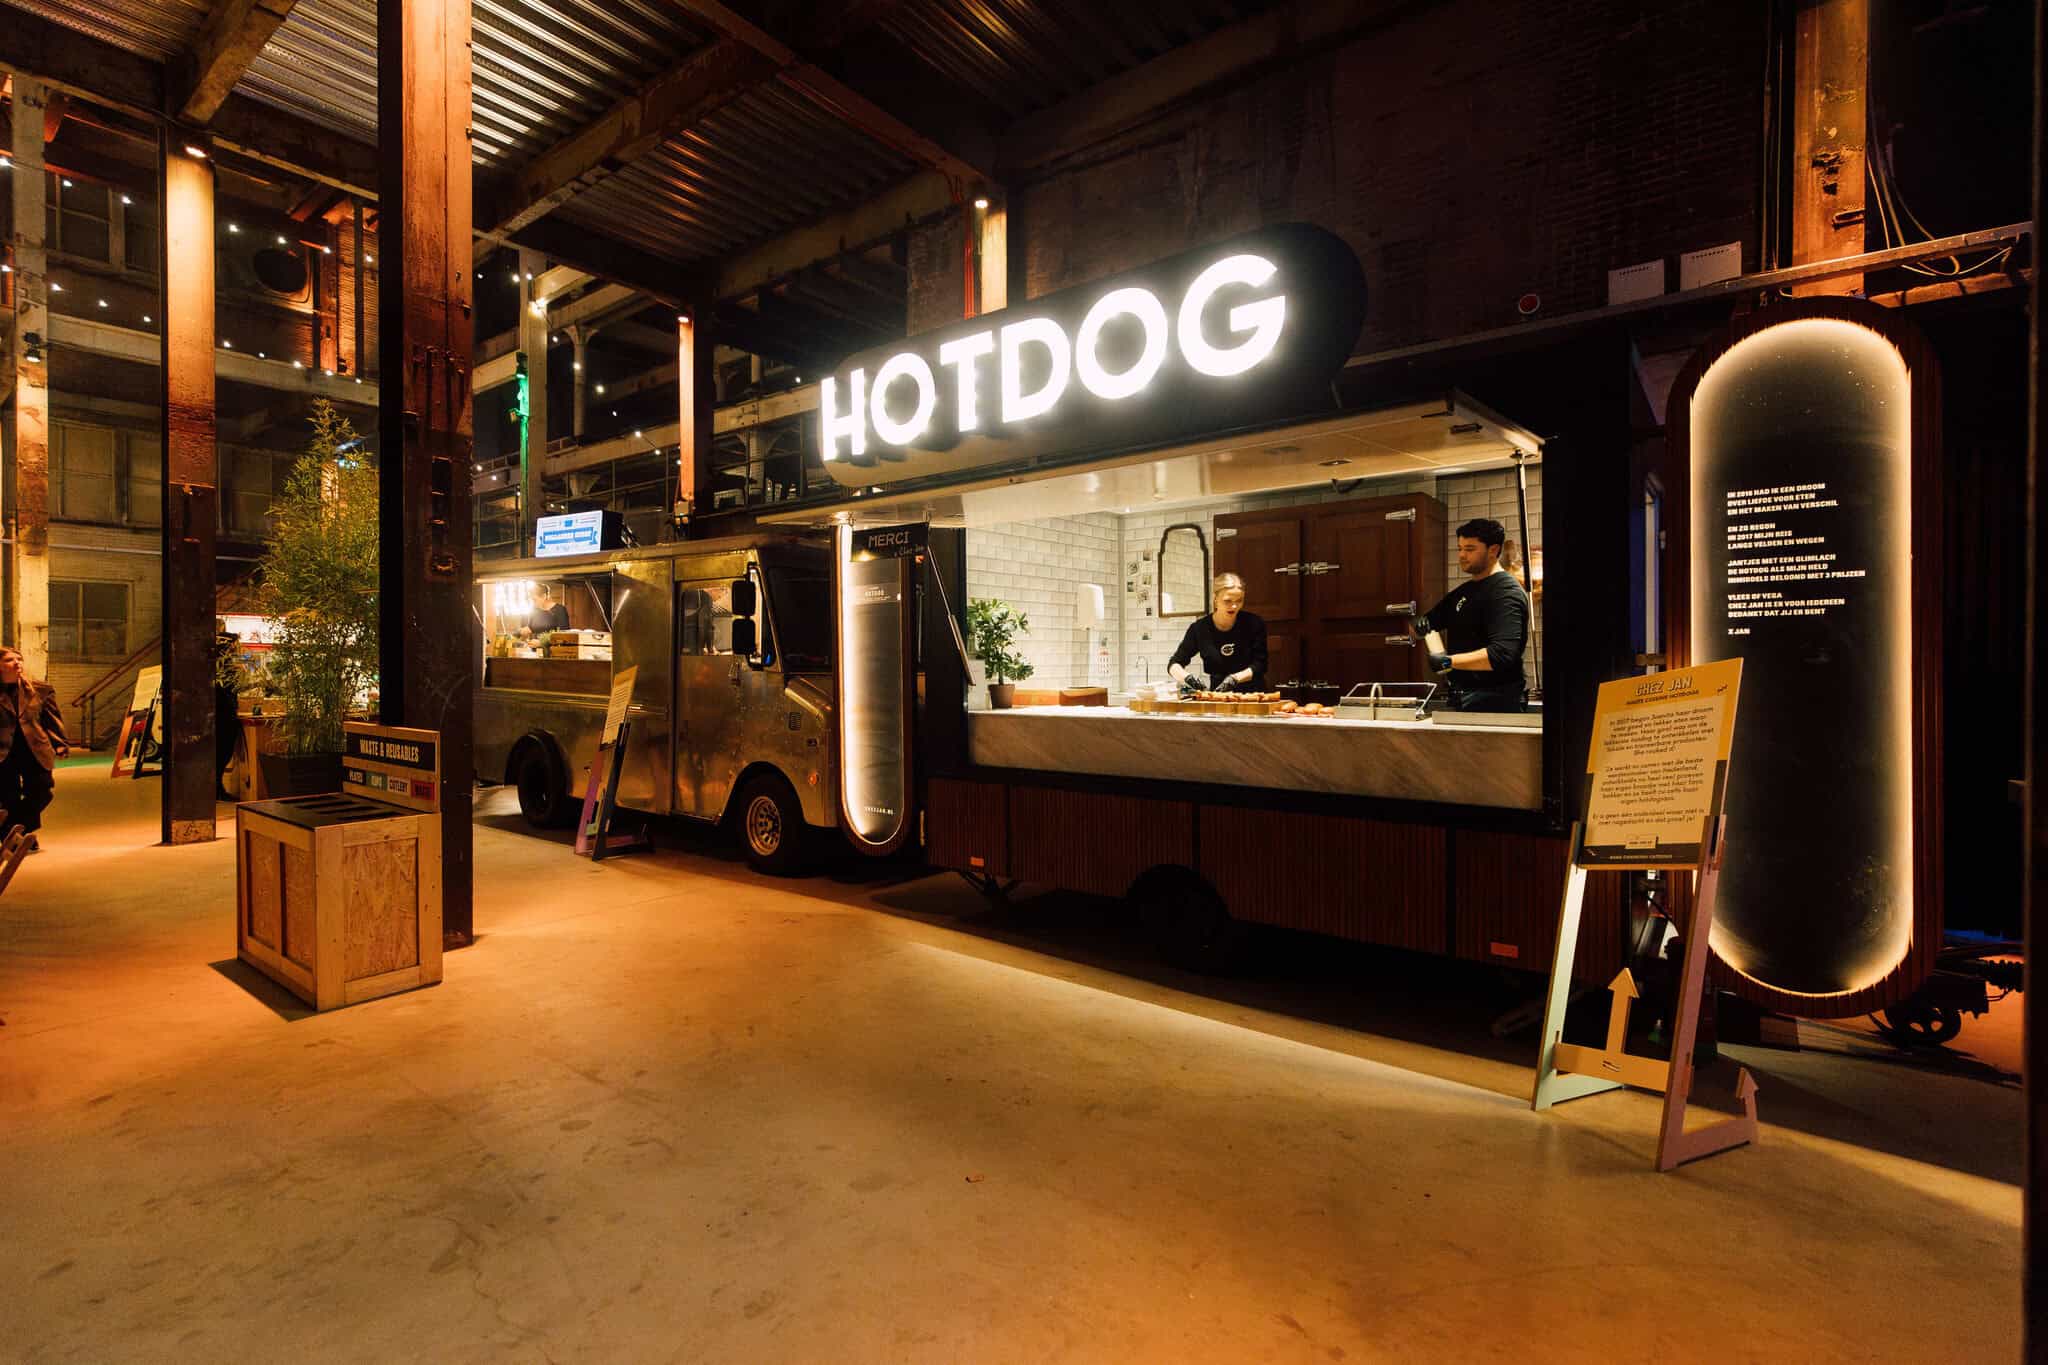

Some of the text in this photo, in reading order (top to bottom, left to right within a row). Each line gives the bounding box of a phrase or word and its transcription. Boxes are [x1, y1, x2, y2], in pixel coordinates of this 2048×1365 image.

[820, 252, 1287, 462] HOTDOG
[1797, 483, 1825, 491] DROOM
[1748, 497, 1772, 505] LIEFDE
[1754, 505, 1782, 513] MAKEN
[1800, 500, 1838, 509] VERSCHIL
[868, 531, 909, 548] MERCI
[1728, 558, 1760, 566] JANTJES
[1796, 554, 1836, 563] GLIMLACH
[1728, 575, 1768, 583] INMIDDELS
[1832, 570, 1865, 578] PRIJZEN
[1739, 566, 1768, 574] HOTDOG
[1635, 676, 1692, 697] CHEZ JAN
[360, 738, 419, 763] WASTE & REUSABLES
